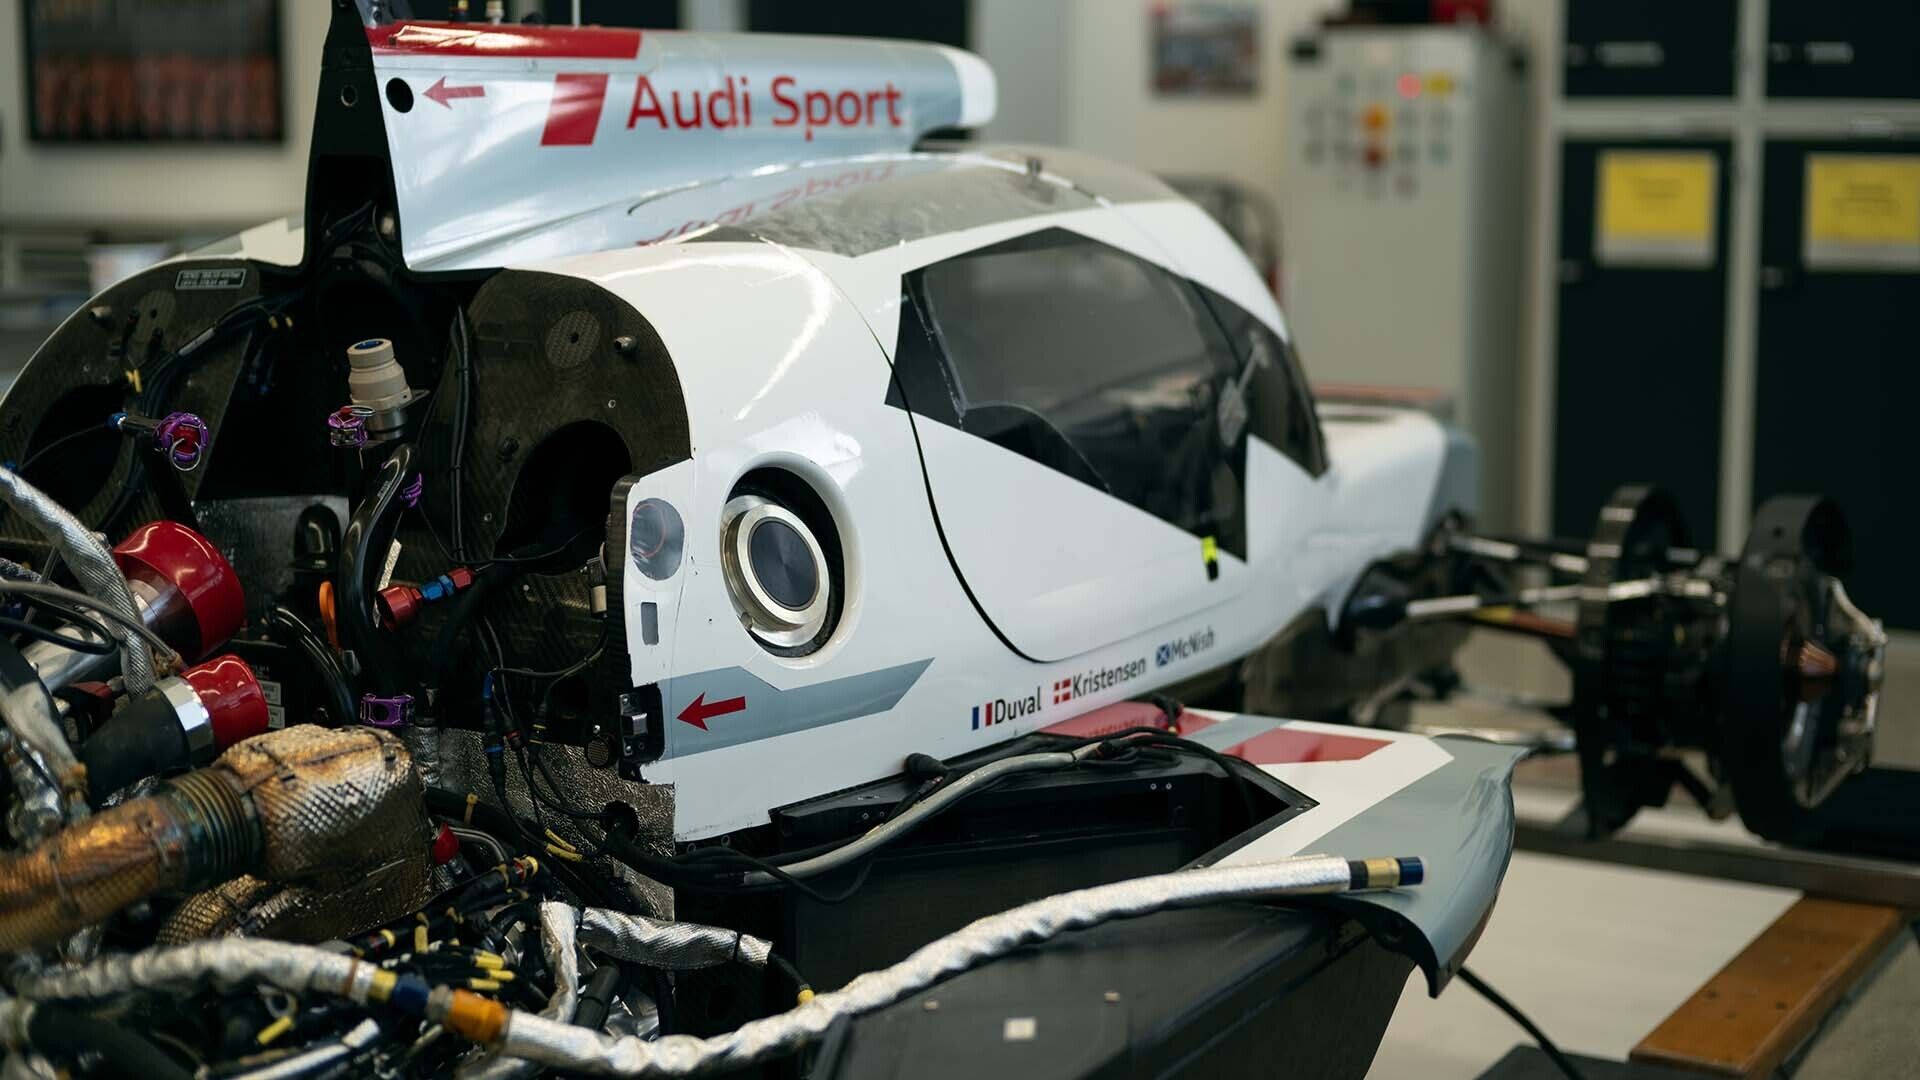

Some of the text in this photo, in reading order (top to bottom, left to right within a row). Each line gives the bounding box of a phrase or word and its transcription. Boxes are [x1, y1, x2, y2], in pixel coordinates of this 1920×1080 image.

[626, 73, 904, 142] Audi Sport
[994, 626, 1215, 724] Duval Kristensen McNish
